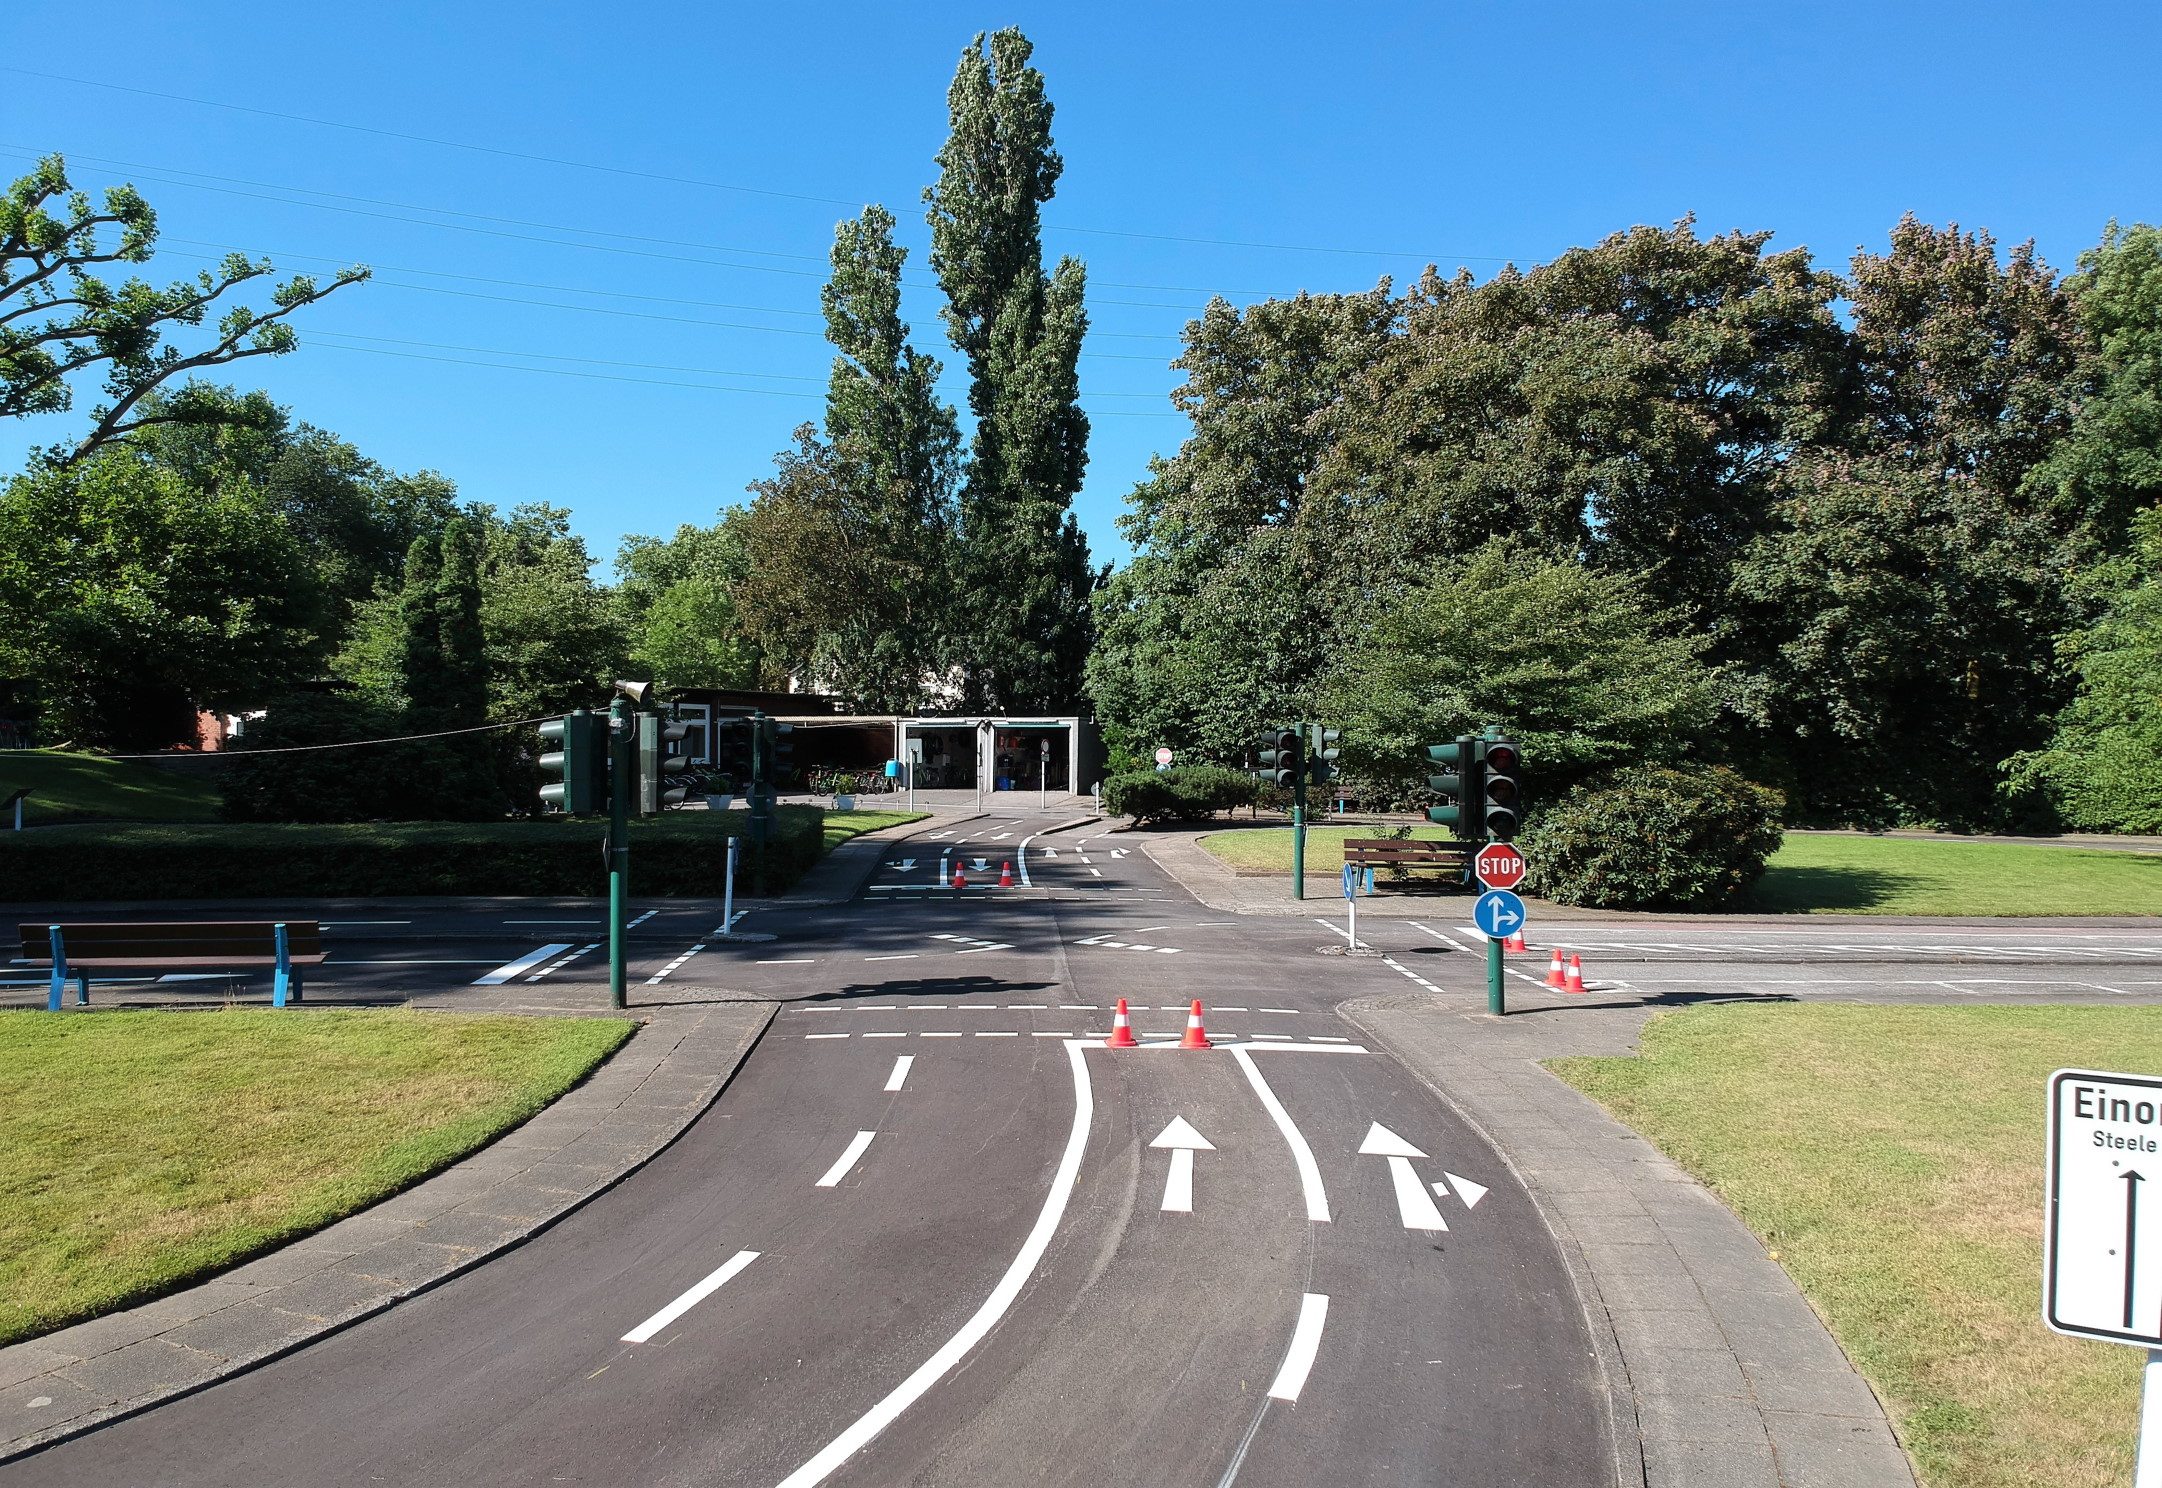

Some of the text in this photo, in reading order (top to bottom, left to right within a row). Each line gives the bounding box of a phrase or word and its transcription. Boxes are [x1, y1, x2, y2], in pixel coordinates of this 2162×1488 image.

[1481, 857, 1521, 875] STOP
[2075, 1086, 2162, 1126] Eino
[2093, 1130, 2157, 1153] Steele
